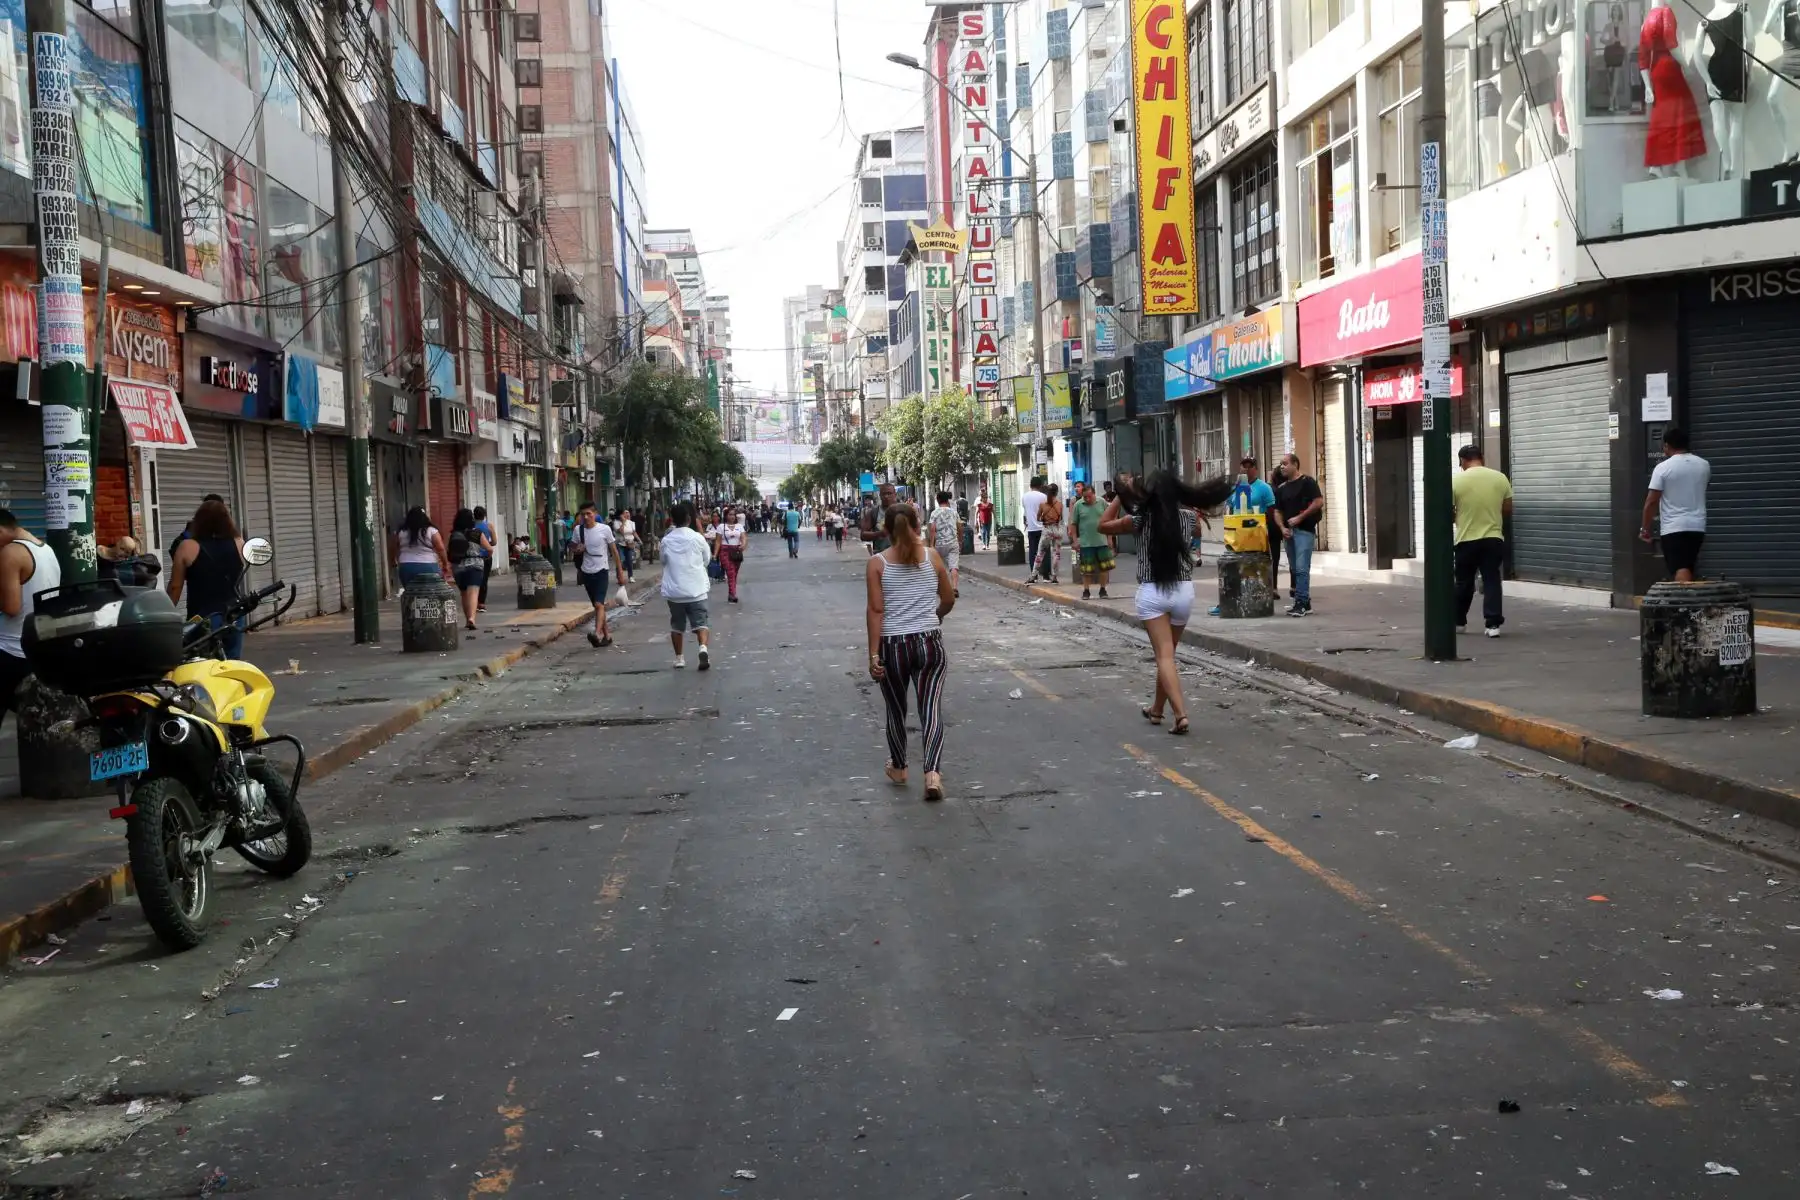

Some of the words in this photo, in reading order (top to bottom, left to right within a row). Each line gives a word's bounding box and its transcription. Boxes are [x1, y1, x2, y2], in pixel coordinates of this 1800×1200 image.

[38, 70, 55, 89] 989
[40, 89, 61, 102] 792
[33, 111, 49, 128] 993
[33, 128, 67, 145] UNION
[1142, 4, 1187, 266] CHIFA
[1771, 180, 1800, 206] T
[41, 196, 61, 213] 993
[925, 231, 956, 239] CENTRO
[46, 247, 65, 261] 996
[919, 241, 960, 250] COMERCIAL
[926, 266, 950, 288] EL
[1431, 277, 1442, 288] DE
[1337, 290, 1391, 340] Bata
[111, 306, 170, 378] Kysem
[979, 368, 998, 381] 756
[1369, 381, 1394, 400] AHORA
[93, 749, 143, 776] 7690-2F
